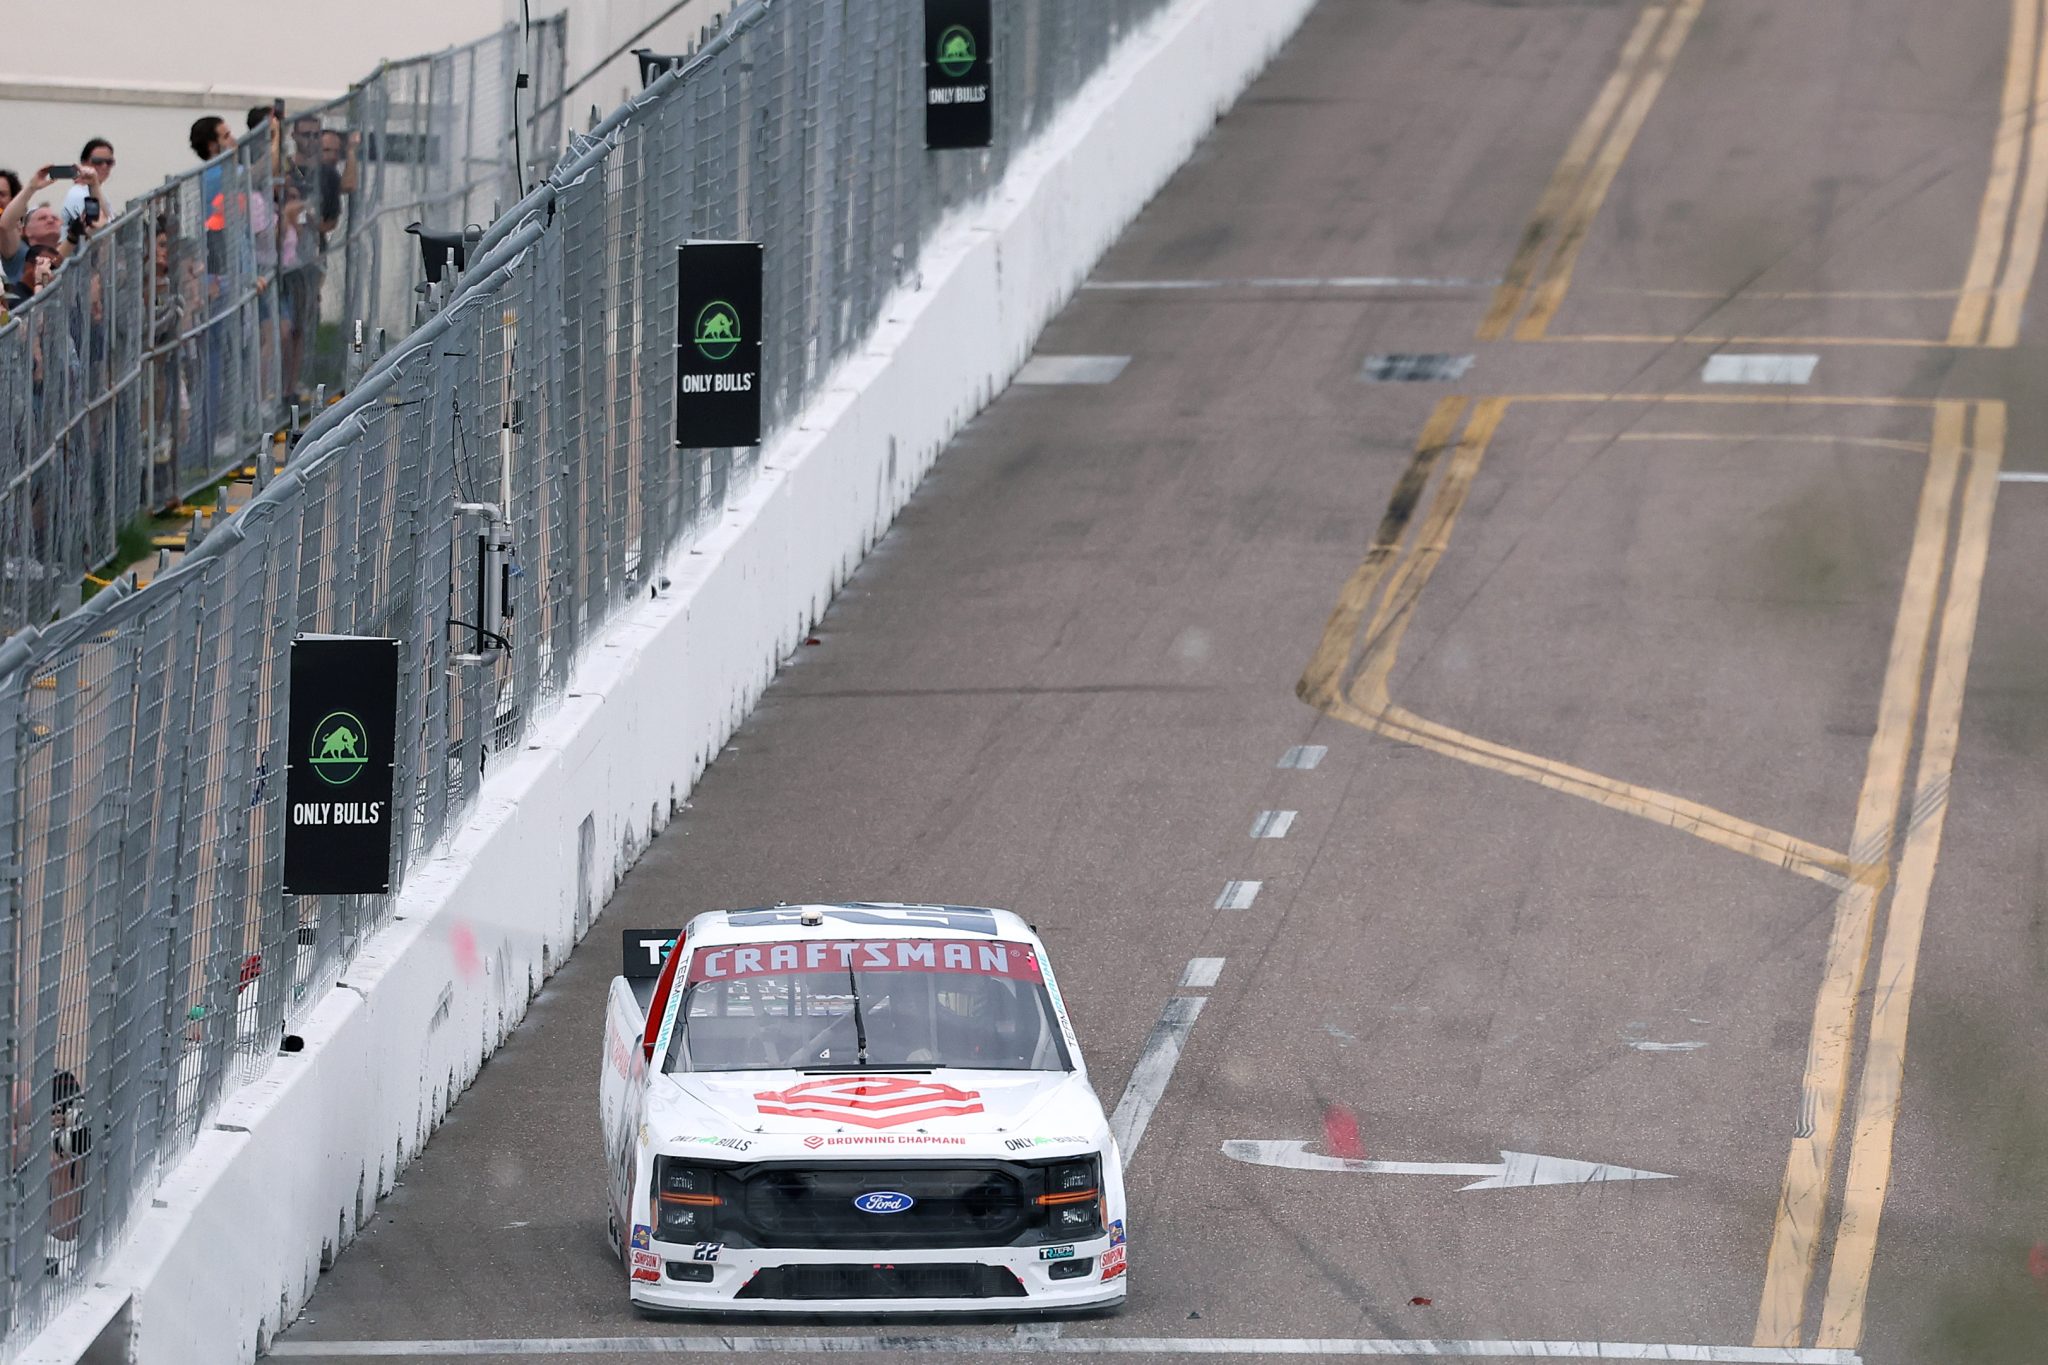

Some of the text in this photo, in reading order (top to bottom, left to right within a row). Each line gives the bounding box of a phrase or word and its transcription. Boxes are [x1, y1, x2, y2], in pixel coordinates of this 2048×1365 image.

[929, 88, 954, 104] ONLY
[682, 374, 712, 393] ONLY
[293, 803, 331, 825] ONLY
[715, 1138, 752, 1152] BULLS
[827, 1136, 895, 1145] BROWNING
[1004, 1137, 1035, 1151] ONLY
[866, 1194, 902, 1210] Ford
[634, 1251, 657, 1268] SIMPSON
[693, 1241, 724, 1262] 22
